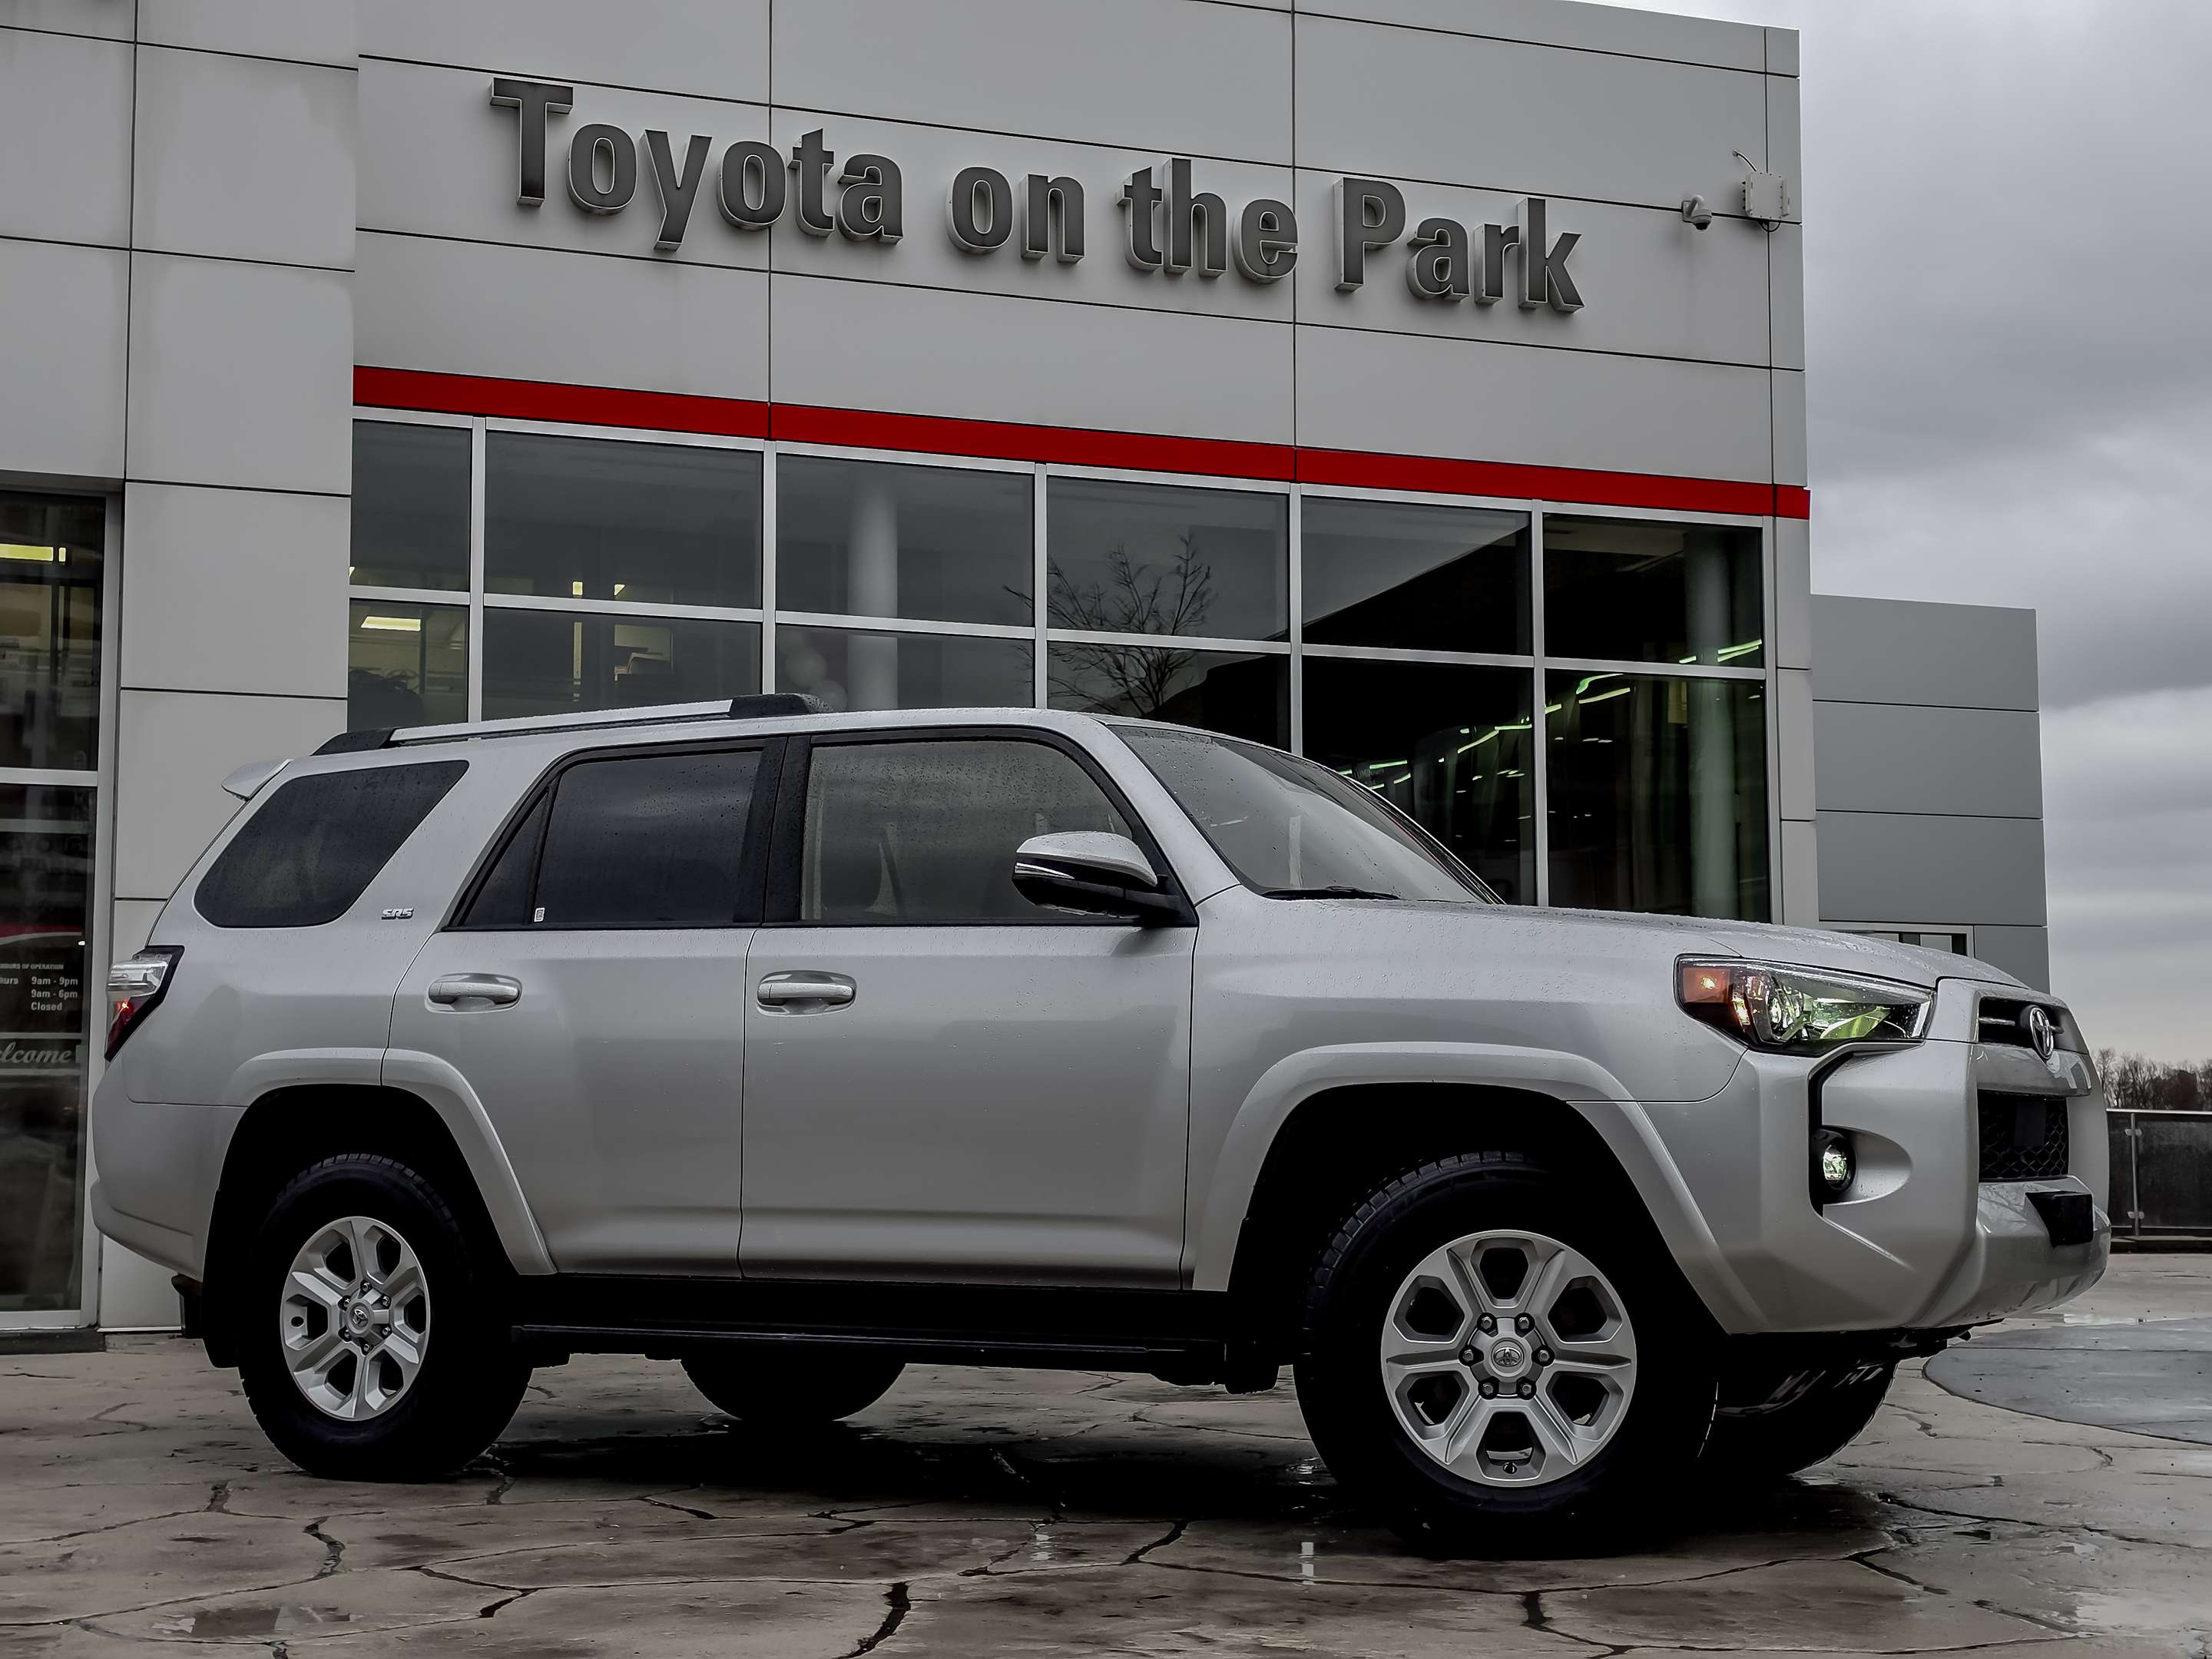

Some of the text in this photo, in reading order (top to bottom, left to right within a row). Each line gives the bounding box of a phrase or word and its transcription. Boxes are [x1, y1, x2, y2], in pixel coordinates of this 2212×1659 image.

[489, 78, 1584, 313] Toyota on the Park
[31, 976, 51, 985] 9am
[59, 976, 78, 988] 9pm
[31, 989, 51, 998] 9am
[58, 989, 78, 1000] 6pm
[31, 1002, 62, 1011] Closed
